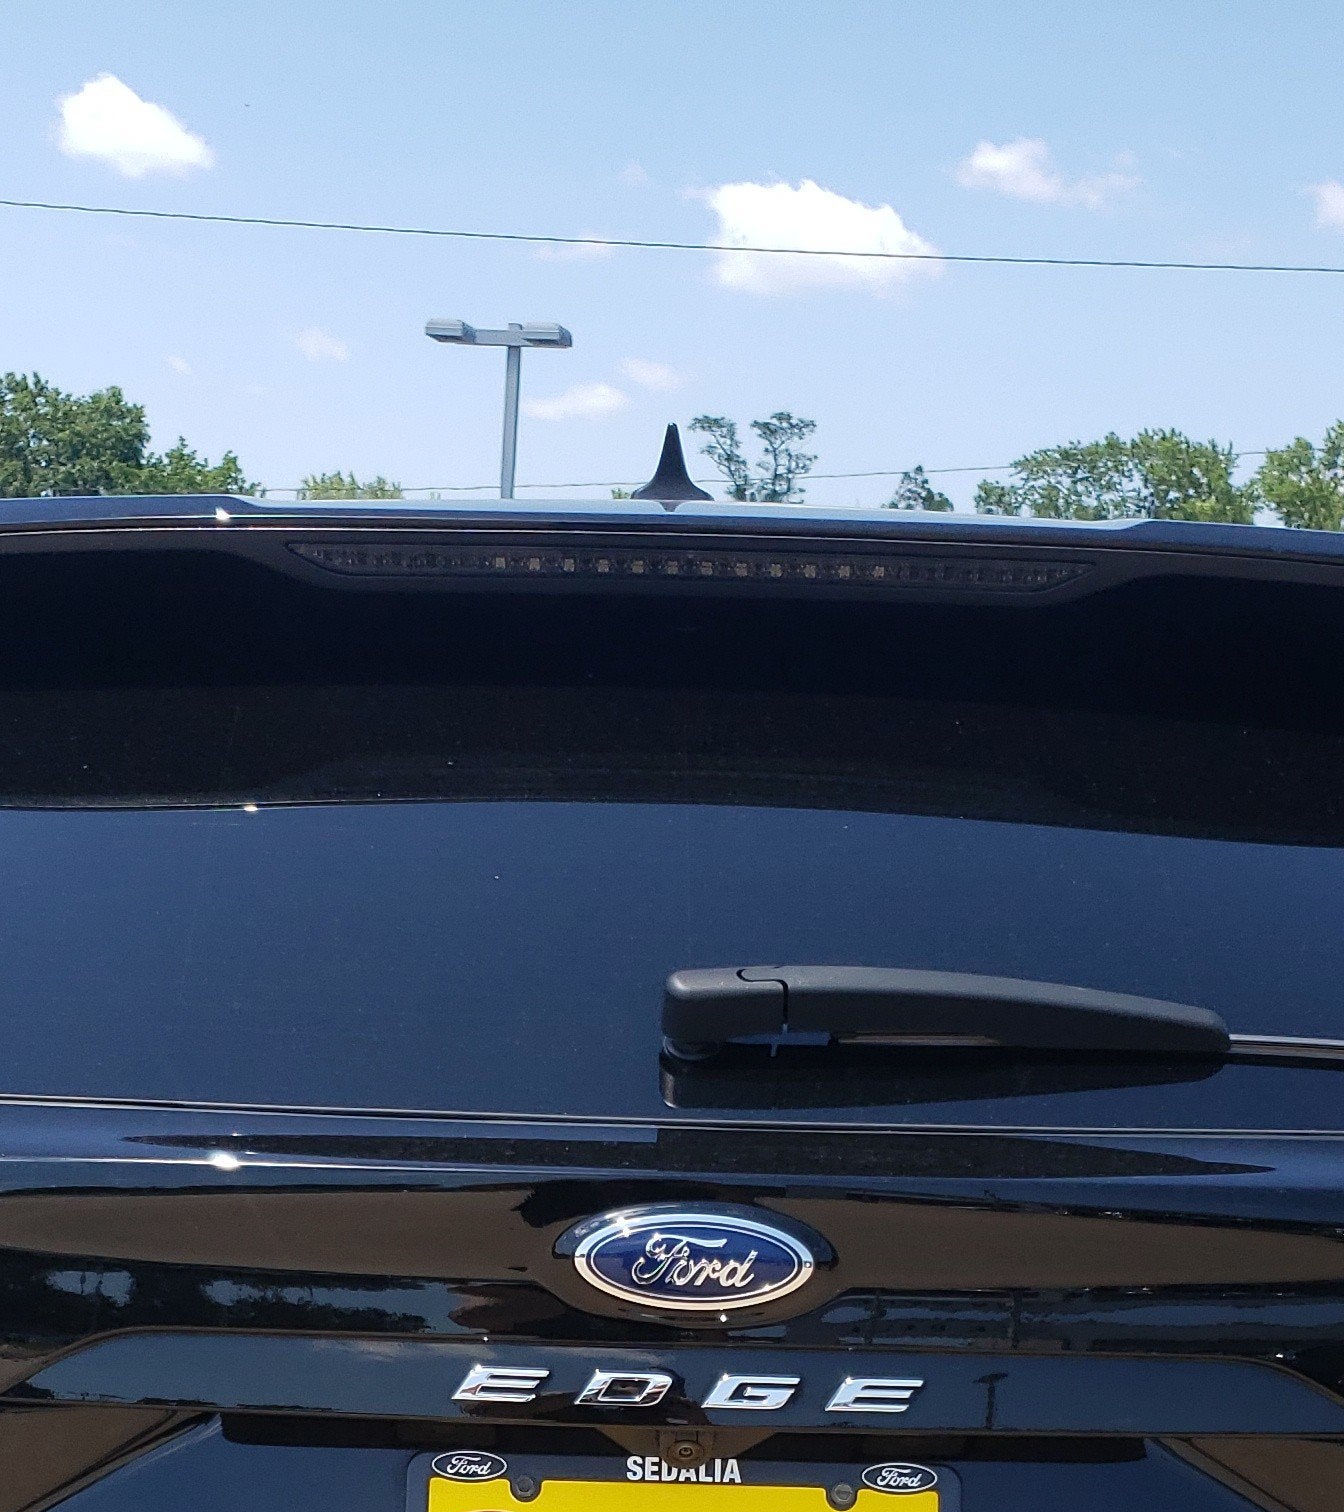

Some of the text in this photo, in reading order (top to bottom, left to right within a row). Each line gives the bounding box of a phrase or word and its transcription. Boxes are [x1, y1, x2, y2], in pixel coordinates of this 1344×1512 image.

[633, 1233, 759, 1289] Ford
[452, 1364, 924, 1413] EDGE
[446, 1455, 492, 1475] Ford
[876, 1467, 922, 1487] Ford
